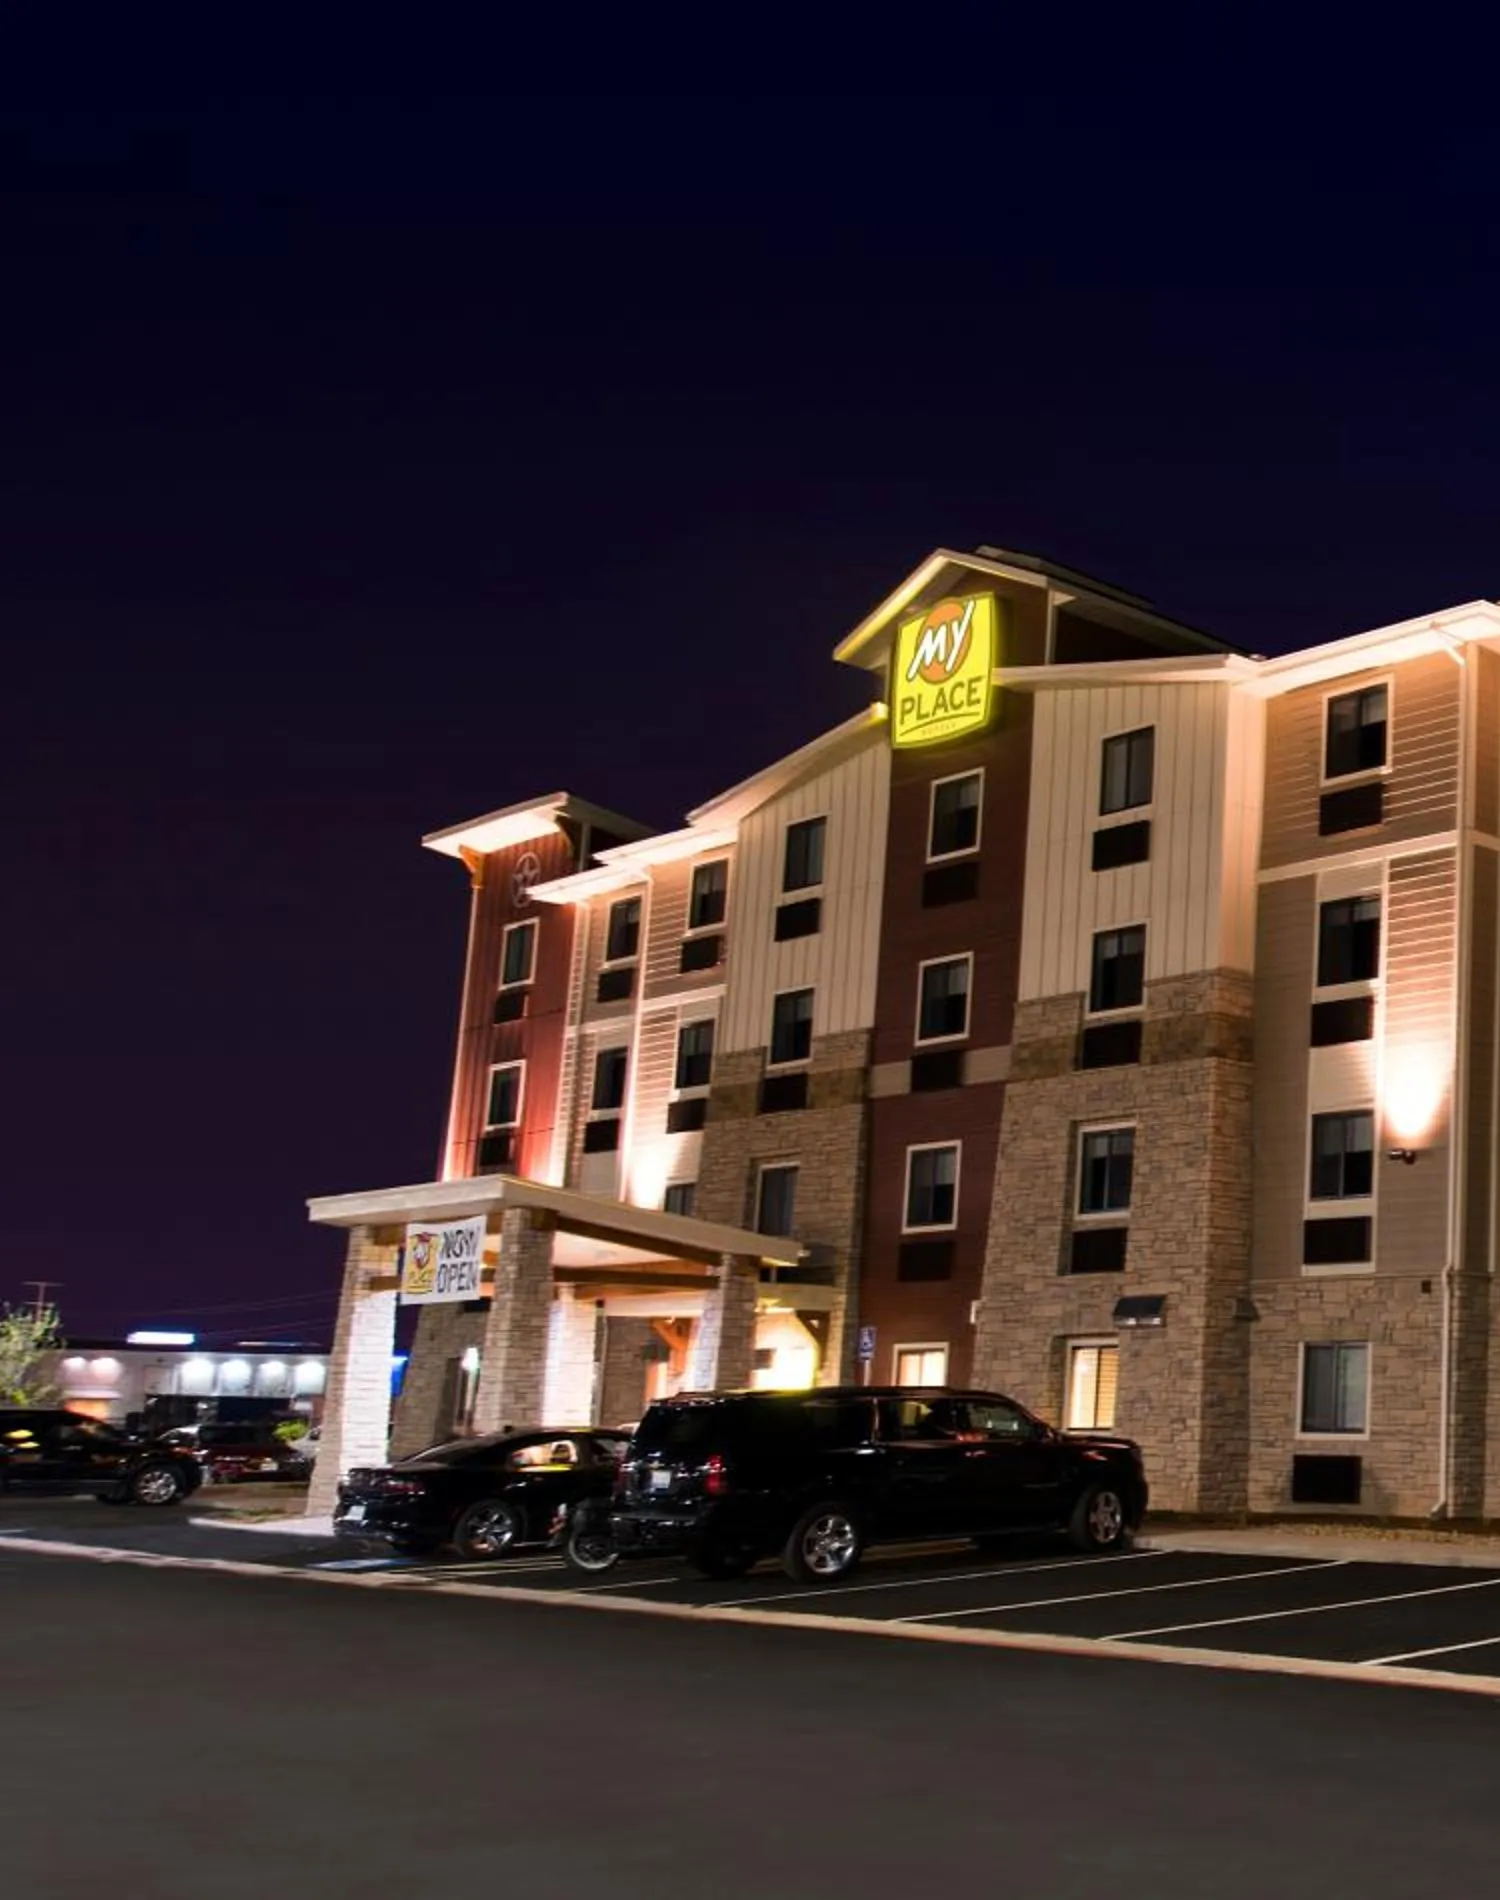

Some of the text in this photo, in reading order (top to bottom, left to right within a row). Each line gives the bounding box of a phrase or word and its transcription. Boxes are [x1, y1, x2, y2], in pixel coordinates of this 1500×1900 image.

[900, 676, 984, 725] PLACE
[441, 1226, 481, 1259] NOW
[437, 1260, 479, 1293] OPEN
